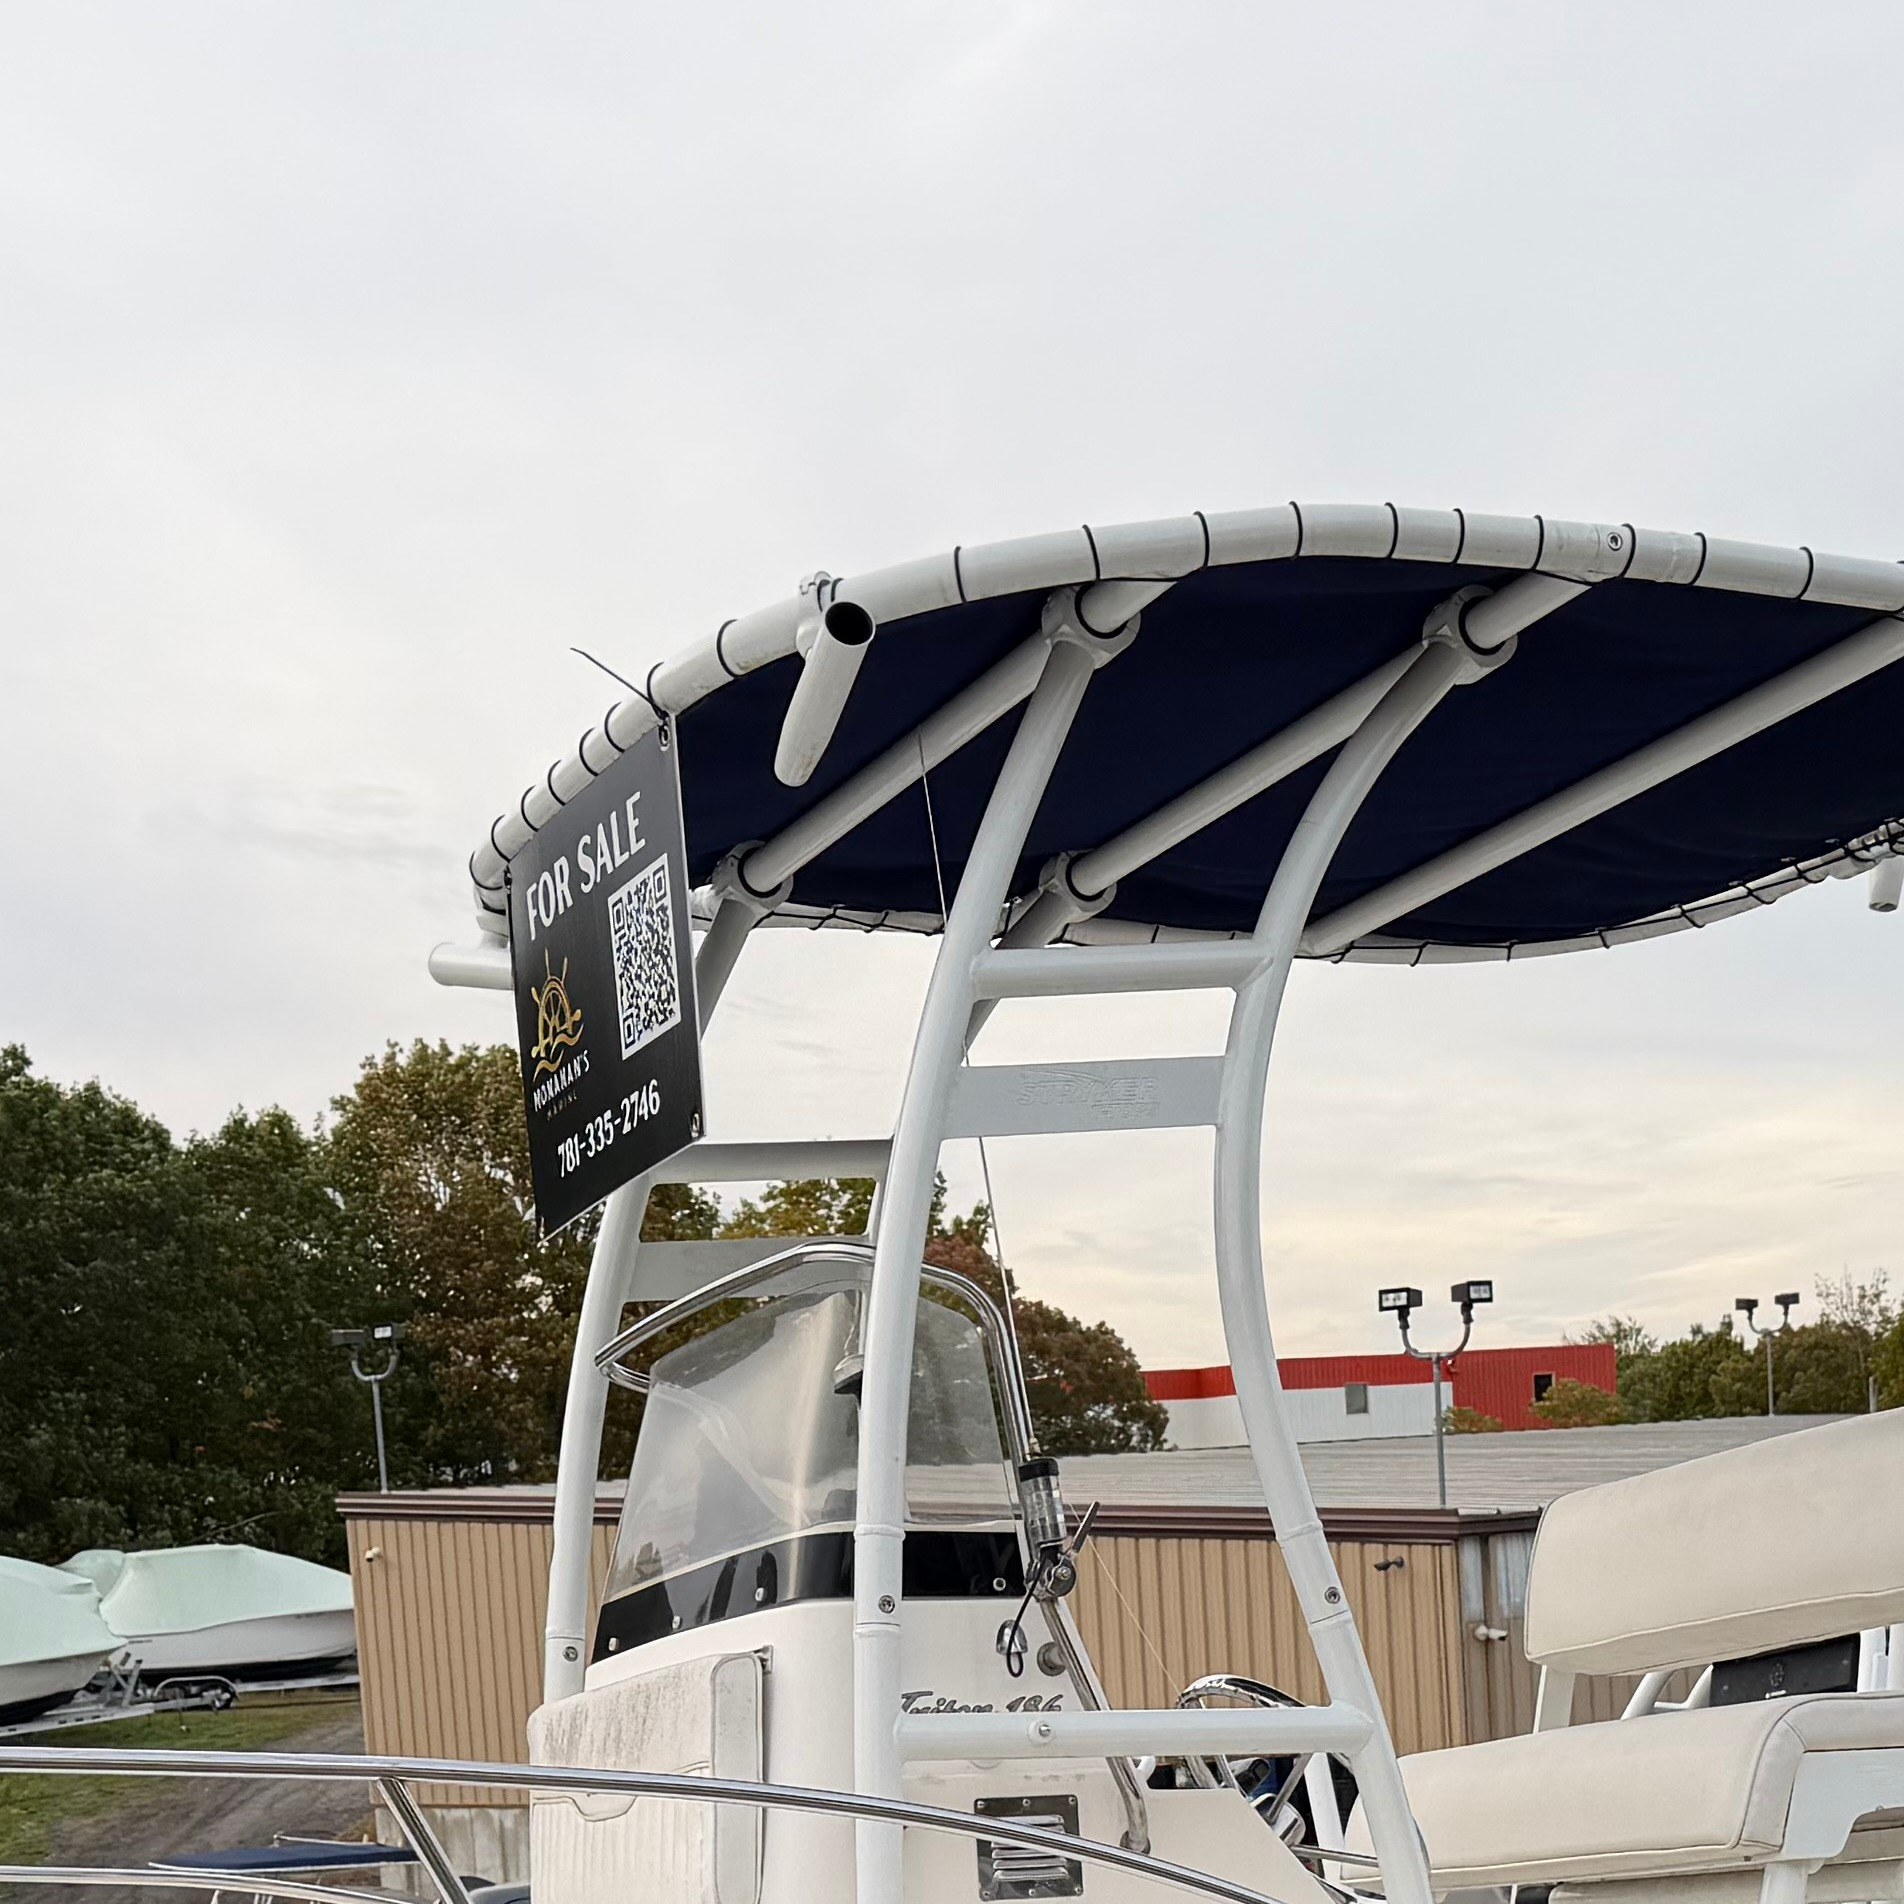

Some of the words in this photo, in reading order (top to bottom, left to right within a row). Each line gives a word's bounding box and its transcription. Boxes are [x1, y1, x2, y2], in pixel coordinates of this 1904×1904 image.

[526, 855, 574, 942] FOR
[577, 791, 646, 894] SALE
[557, 1079, 661, 1178] 781-335-2746
